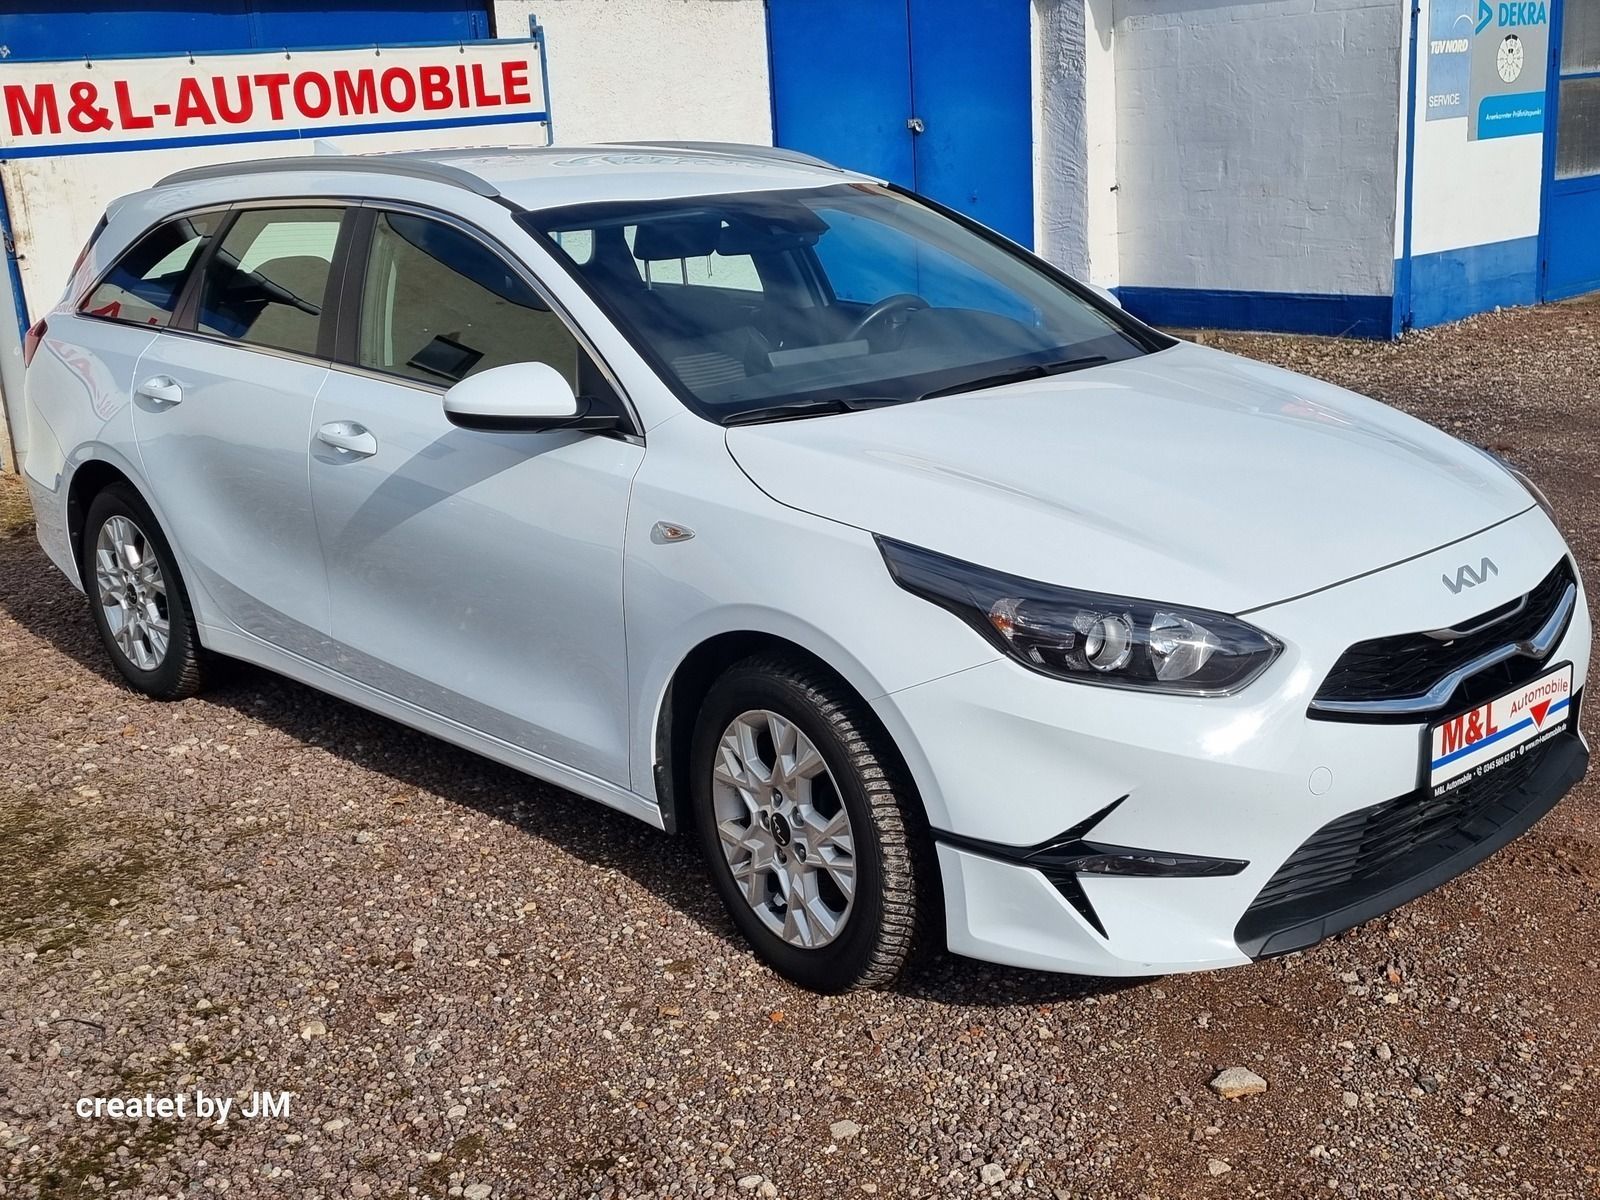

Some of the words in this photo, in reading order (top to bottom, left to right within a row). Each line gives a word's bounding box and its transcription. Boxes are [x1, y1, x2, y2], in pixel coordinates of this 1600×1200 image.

[1498, 2, 1547, 27] DEKRA
[1446, 38, 1469, 53] NORD
[3, 60, 531, 136] M&L-AUTOMOBILE
[1429, 93, 1460, 108] SERVICE
[1509, 678, 1569, 718] Automobile
[1441, 703, 1498, 756] M&L
[1446, 773, 1472, 791] Automobile
